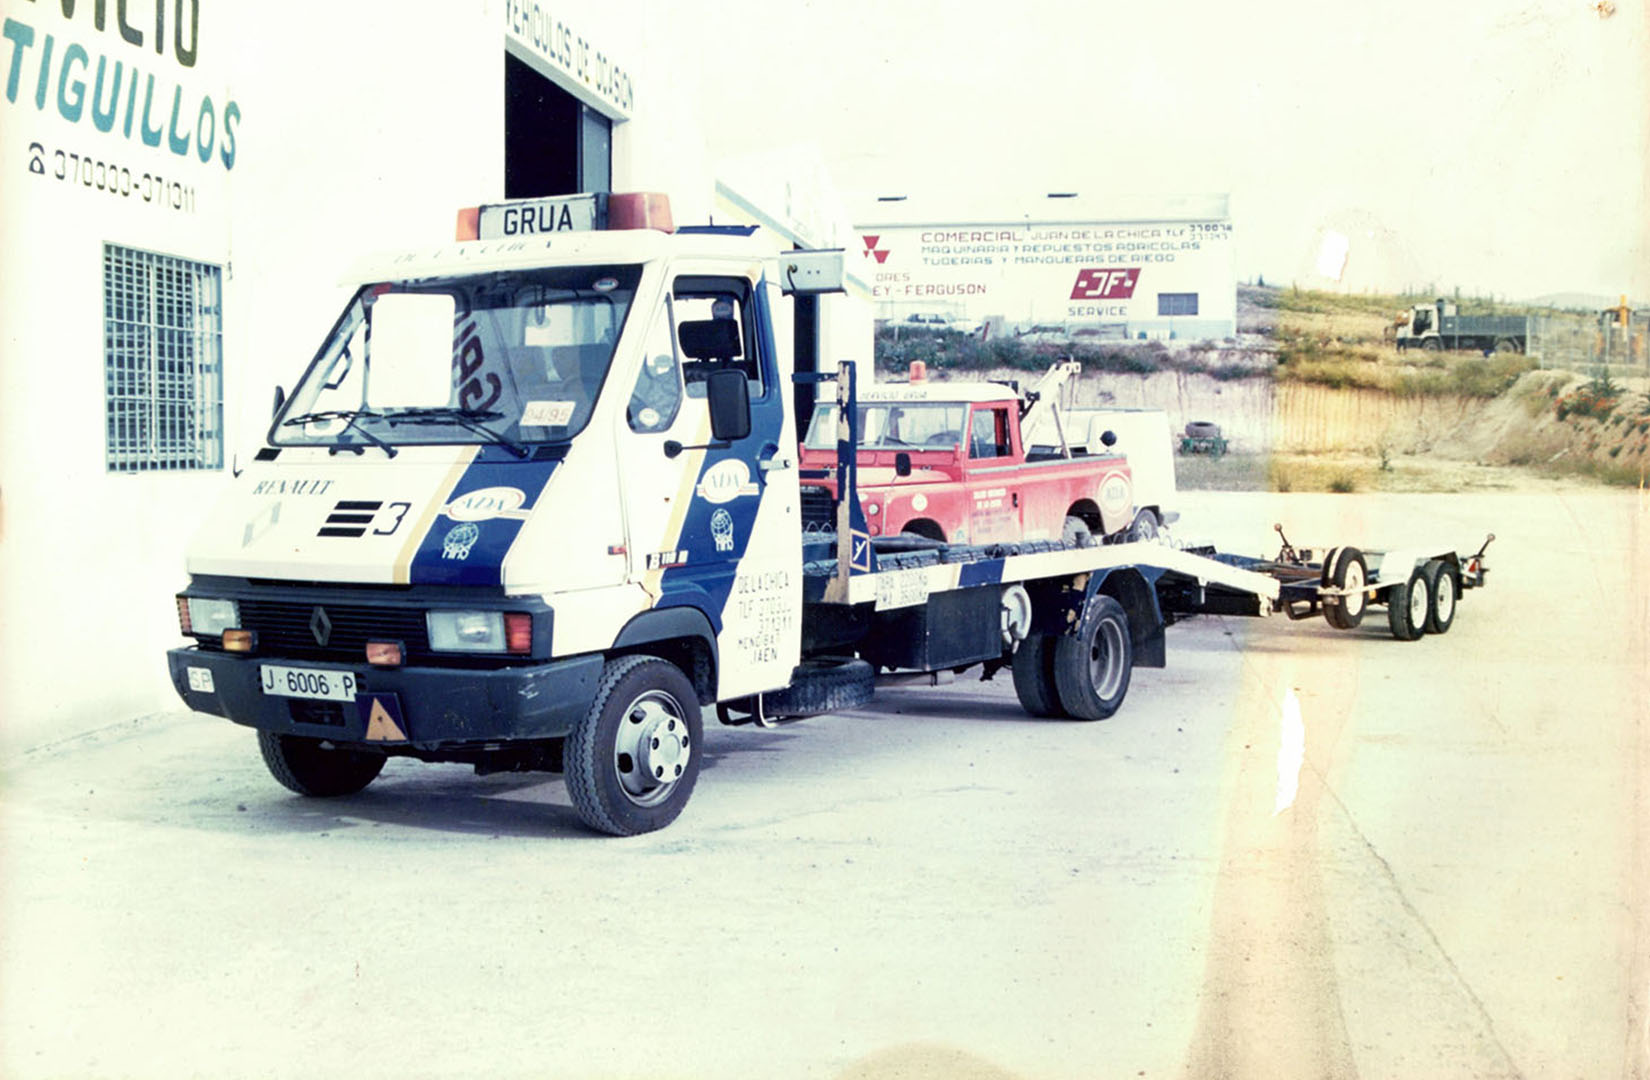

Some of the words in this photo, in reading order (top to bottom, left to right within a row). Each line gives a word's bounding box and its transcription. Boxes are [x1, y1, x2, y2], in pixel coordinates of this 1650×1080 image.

[2, 17, 241, 171] TIGUILLOS
[504, 203, 573, 236] GRUA
[921, 231, 1023, 243] COMERCIAL
[1031, 230, 1068, 241] JUAN
[1022, 243, 1113, 253] REPUESTOS
[1068, 306, 1127, 317] SERVICE
[253, 480, 335, 495] RENAULT
